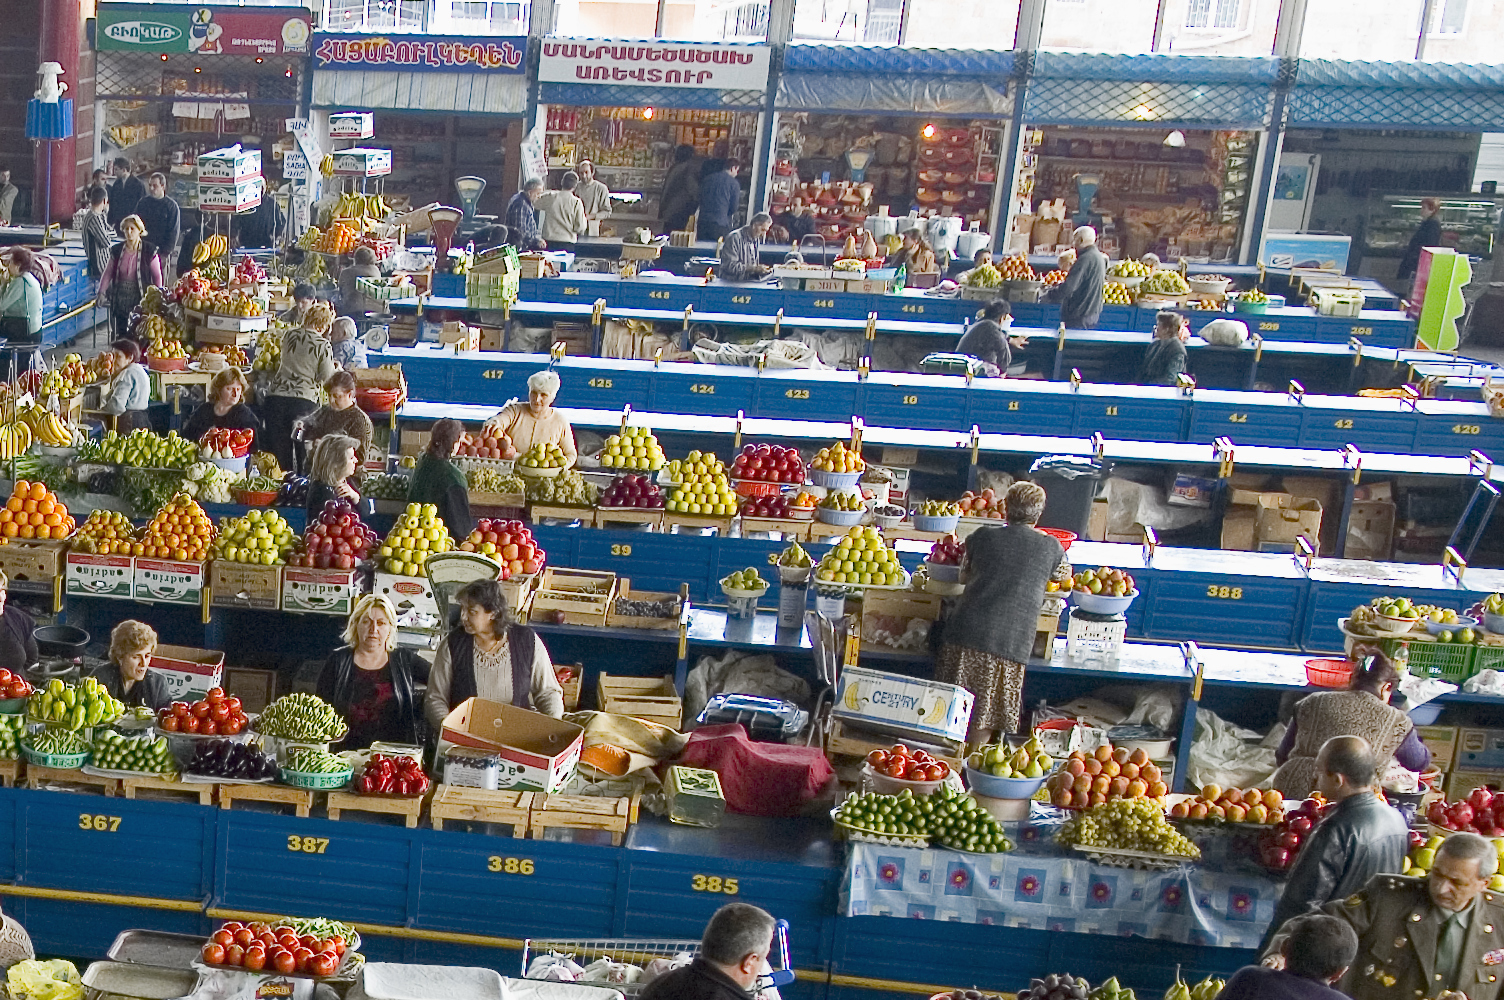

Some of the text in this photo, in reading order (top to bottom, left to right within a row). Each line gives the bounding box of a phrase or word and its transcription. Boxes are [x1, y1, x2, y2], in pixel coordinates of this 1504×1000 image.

[544, 44, 753, 64] ՄԱՆՐԱՄԵԾԱԾԱԽ
[576, 65, 713, 84] ԱՌԵՎՏՈՒՐ
[482, 369, 504, 379] 417
[587, 379, 613, 389] 425
[689, 384, 716, 395] 424
[784, 389, 810, 399] 423
[1206, 584, 1243, 600] 388
[872, 690, 920, 710] CENTURY
[888, 700, 900, 708] 21
[78, 813, 123, 832] 367
[287, 834, 330, 854] 387
[487, 855, 535, 876] 386
[691, 874, 739, 896] 385
